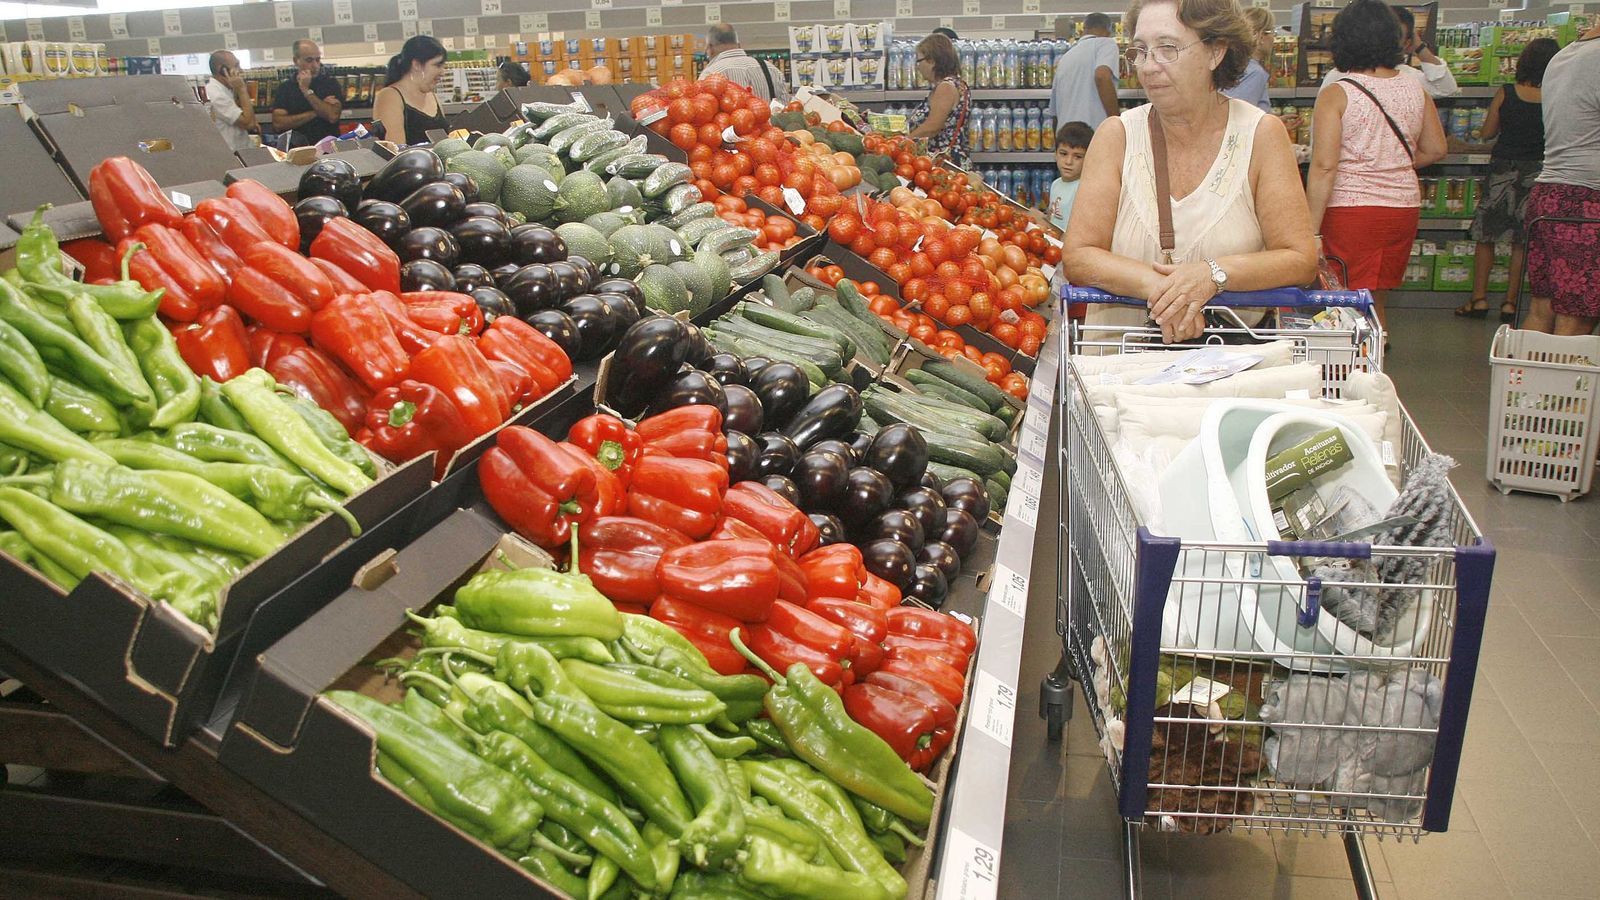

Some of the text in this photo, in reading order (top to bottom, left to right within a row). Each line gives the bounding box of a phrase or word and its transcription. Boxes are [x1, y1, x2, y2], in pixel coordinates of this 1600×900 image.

[1304, 435, 1337, 455] Aceitunas
[1266, 461, 1297, 480] ultivador
[1011, 573, 1026, 592] 1,05
[996, 684, 1014, 709] 1,79
[973, 847, 997, 881] 1,29
